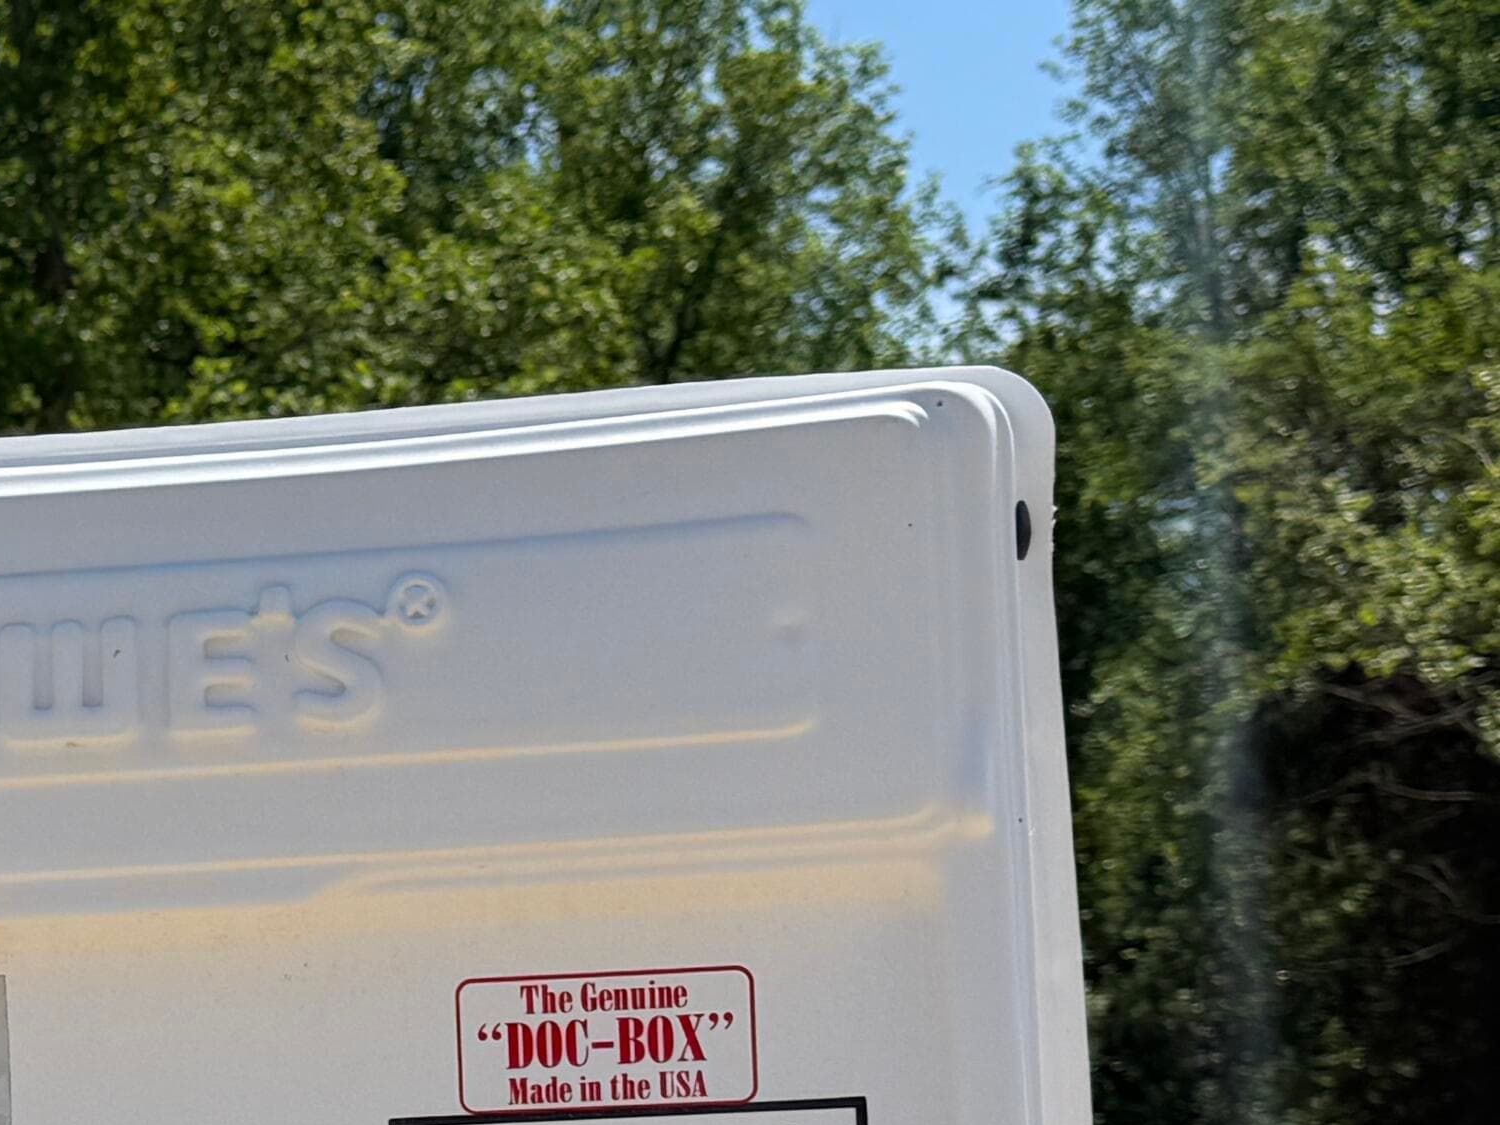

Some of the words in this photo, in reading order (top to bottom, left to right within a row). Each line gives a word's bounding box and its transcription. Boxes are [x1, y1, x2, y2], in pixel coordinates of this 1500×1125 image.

[520, 984, 574, 1016] The
[580, 980, 688, 1013] Genuine
[508, 1076, 573, 1106] Made
[579, 1076, 603, 1102] in
[610, 1073, 652, 1101] the
[659, 1069, 709, 1100] USA
